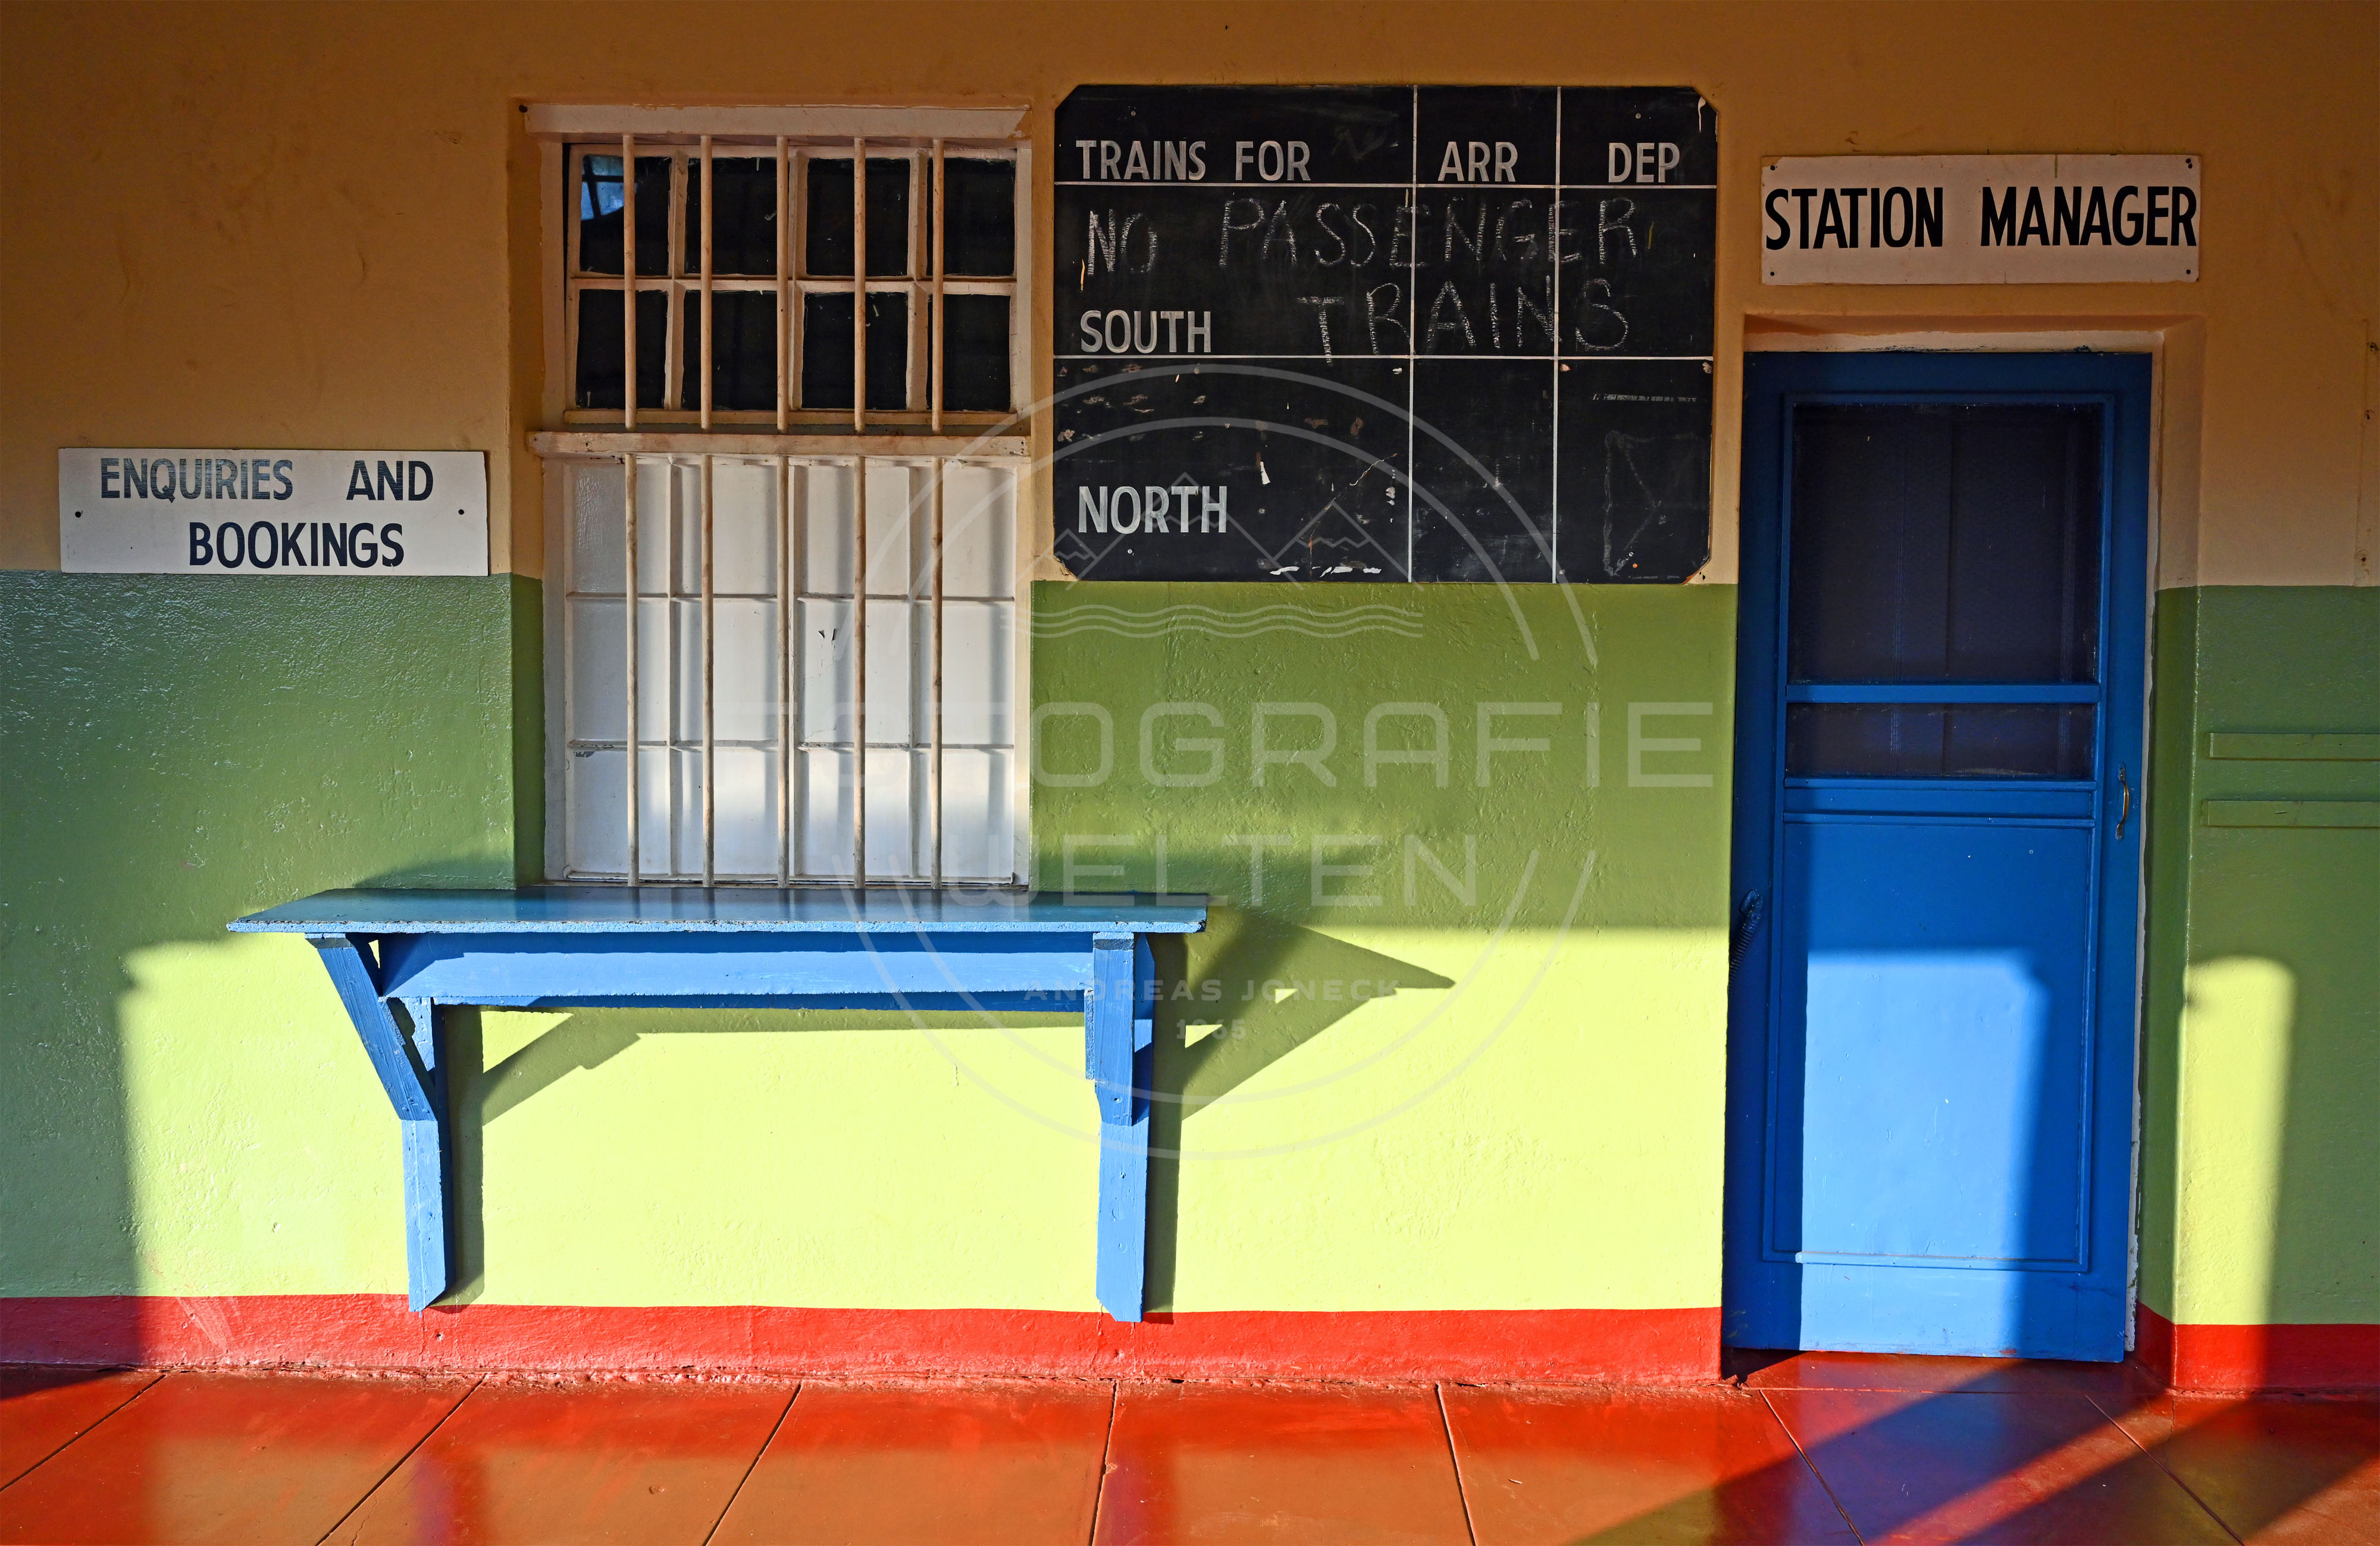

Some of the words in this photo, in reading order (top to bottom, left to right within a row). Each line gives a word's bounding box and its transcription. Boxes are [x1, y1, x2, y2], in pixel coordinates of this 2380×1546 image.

[1076, 140, 1207, 181] TRAINS
[1235, 140, 1310, 181] FOR
[1438, 142, 1518, 183] ARR
[1608, 142, 1680, 184] DEP
[1088, 209, 1157, 276] NO
[1219, 196, 1637, 268] PASSENGER
[1765, 186, 1943, 250] STATION
[1980, 186, 2197, 247] MANAGER
[1081, 310, 1212, 353] SOUTH
[1297, 276, 1629, 366] TRAINS
[101, 458, 293, 502] ENQUIRIES
[346, 460, 434, 501] AND
[1078, 485, 1228, 534] NORTH
[190, 521, 404, 568] BOOKINGS
